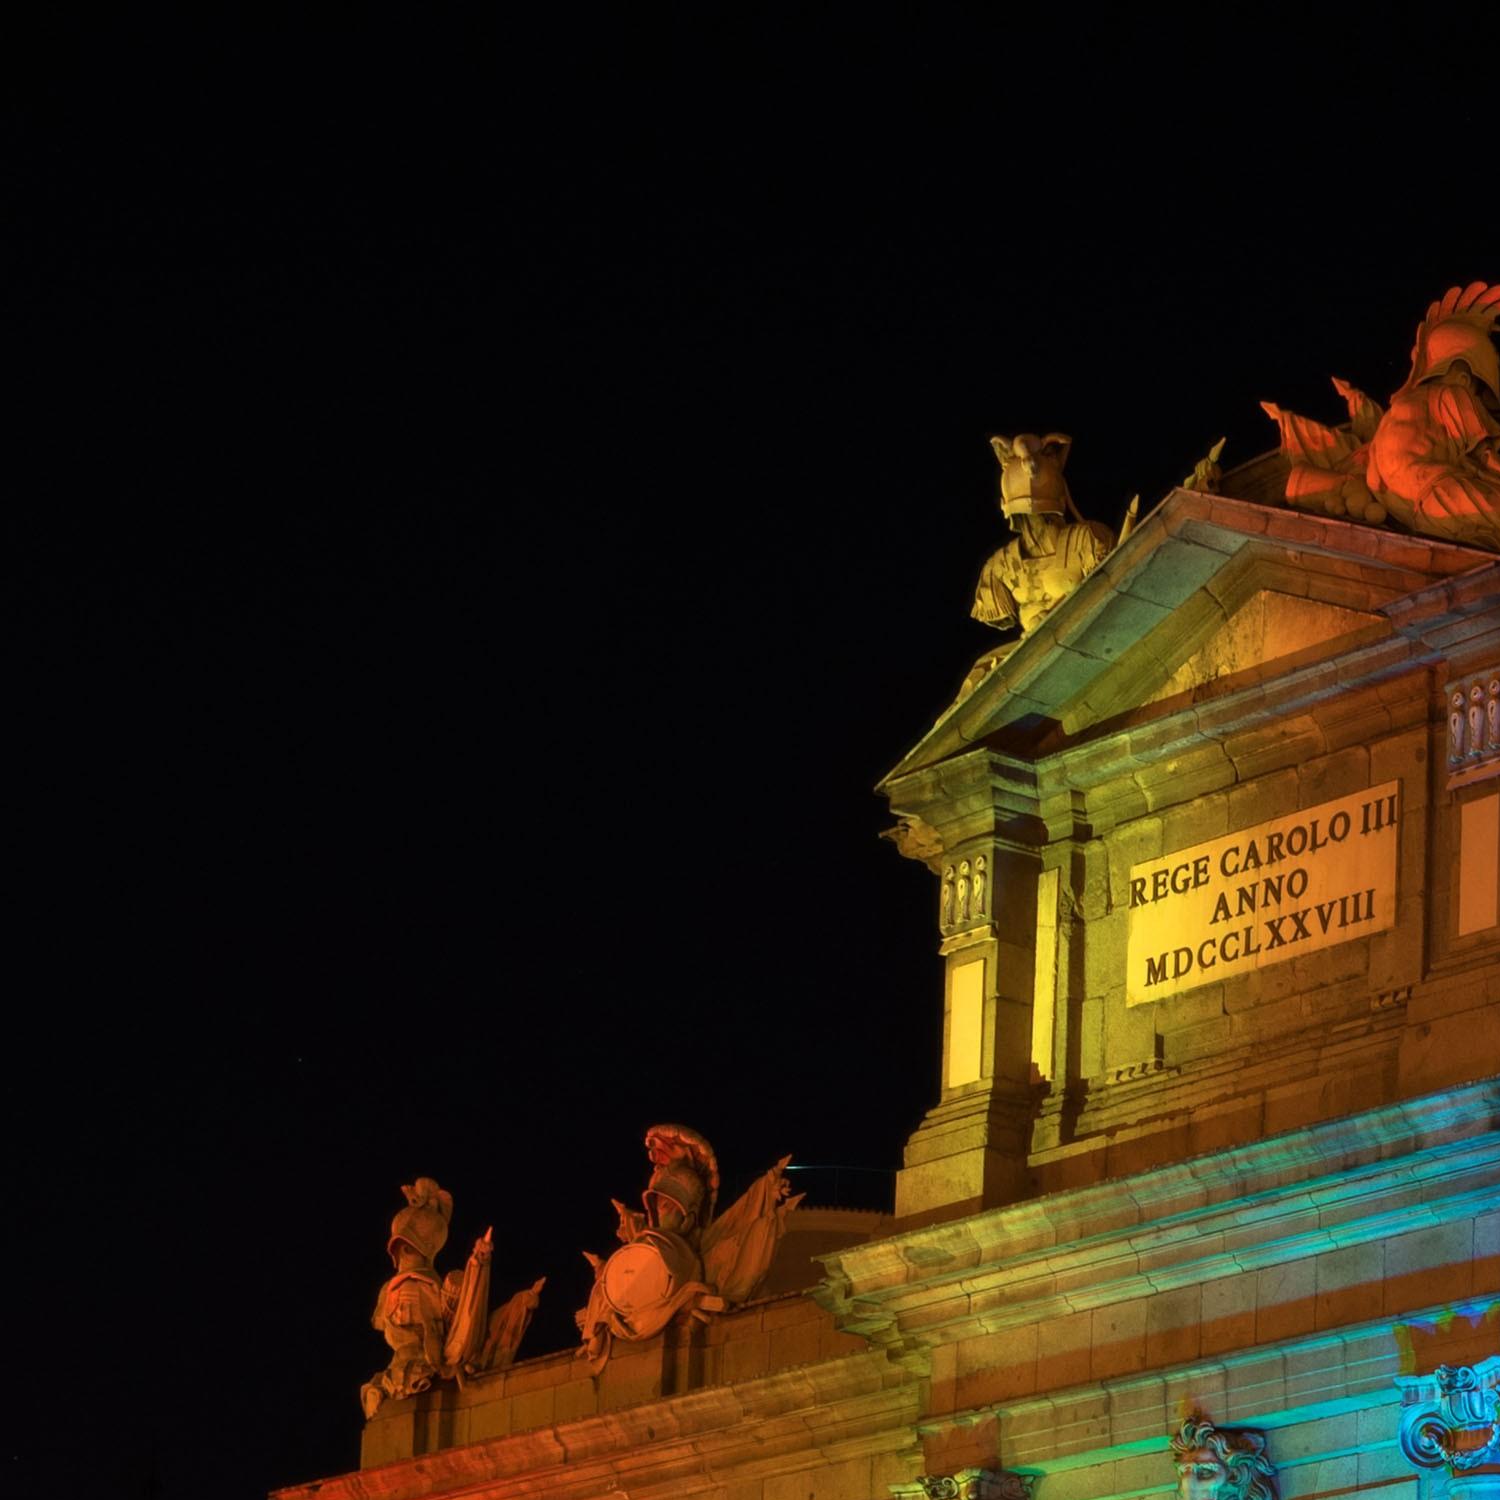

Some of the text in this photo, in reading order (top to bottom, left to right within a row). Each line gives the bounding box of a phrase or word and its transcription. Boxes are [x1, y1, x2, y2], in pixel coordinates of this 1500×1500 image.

[1128, 795, 1397, 910] REGE CAROLO III
[1209, 868, 1309, 925] ANNO
[1144, 889, 1376, 987] MDCCLXXVIII
